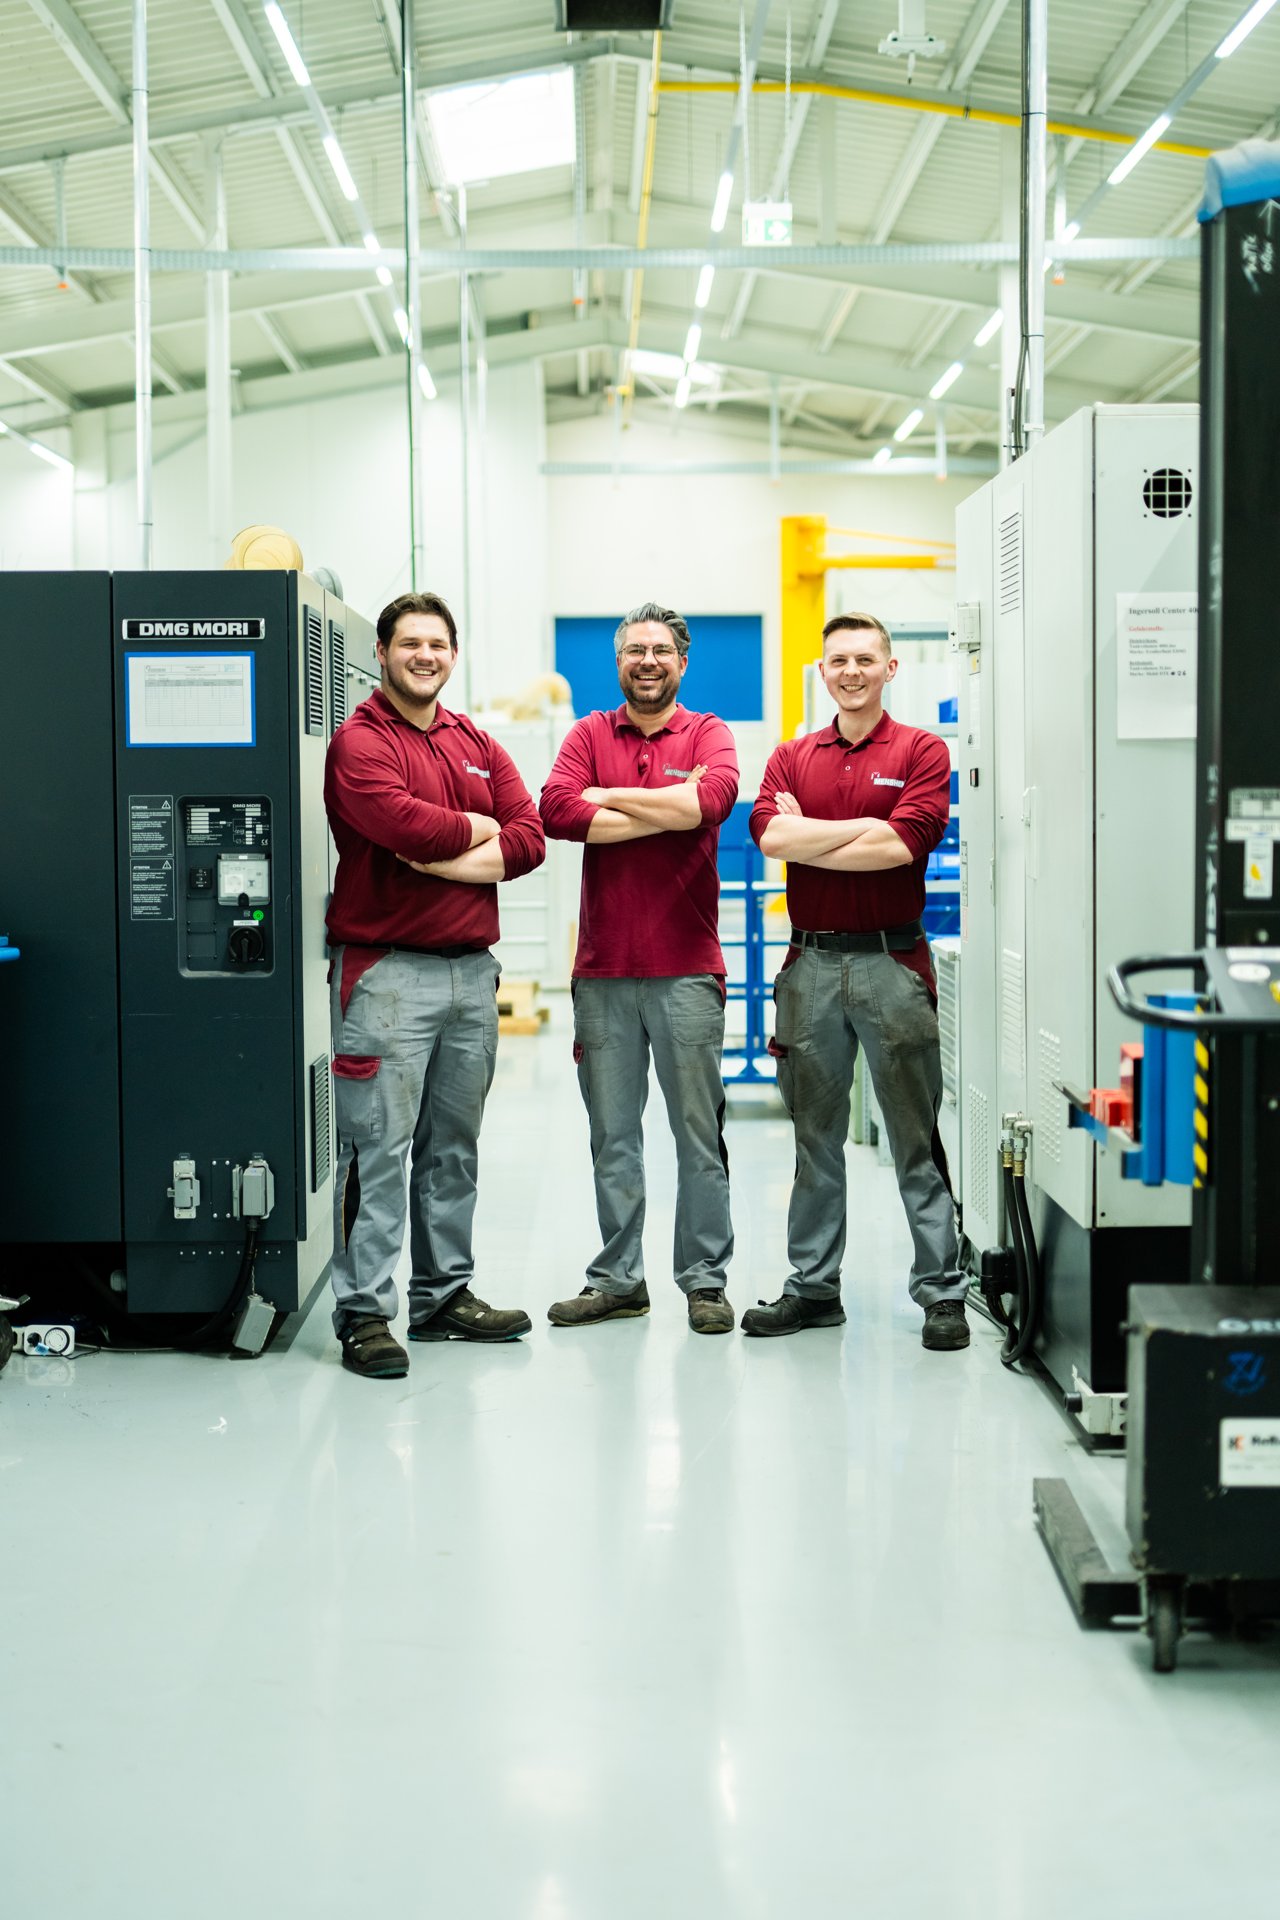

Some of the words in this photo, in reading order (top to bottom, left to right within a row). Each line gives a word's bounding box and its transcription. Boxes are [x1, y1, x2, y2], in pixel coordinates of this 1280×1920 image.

[1129, 607, 1161, 616] Ingersoll
[139, 622, 190, 636] DMG
[192, 622, 249, 636] MORI
